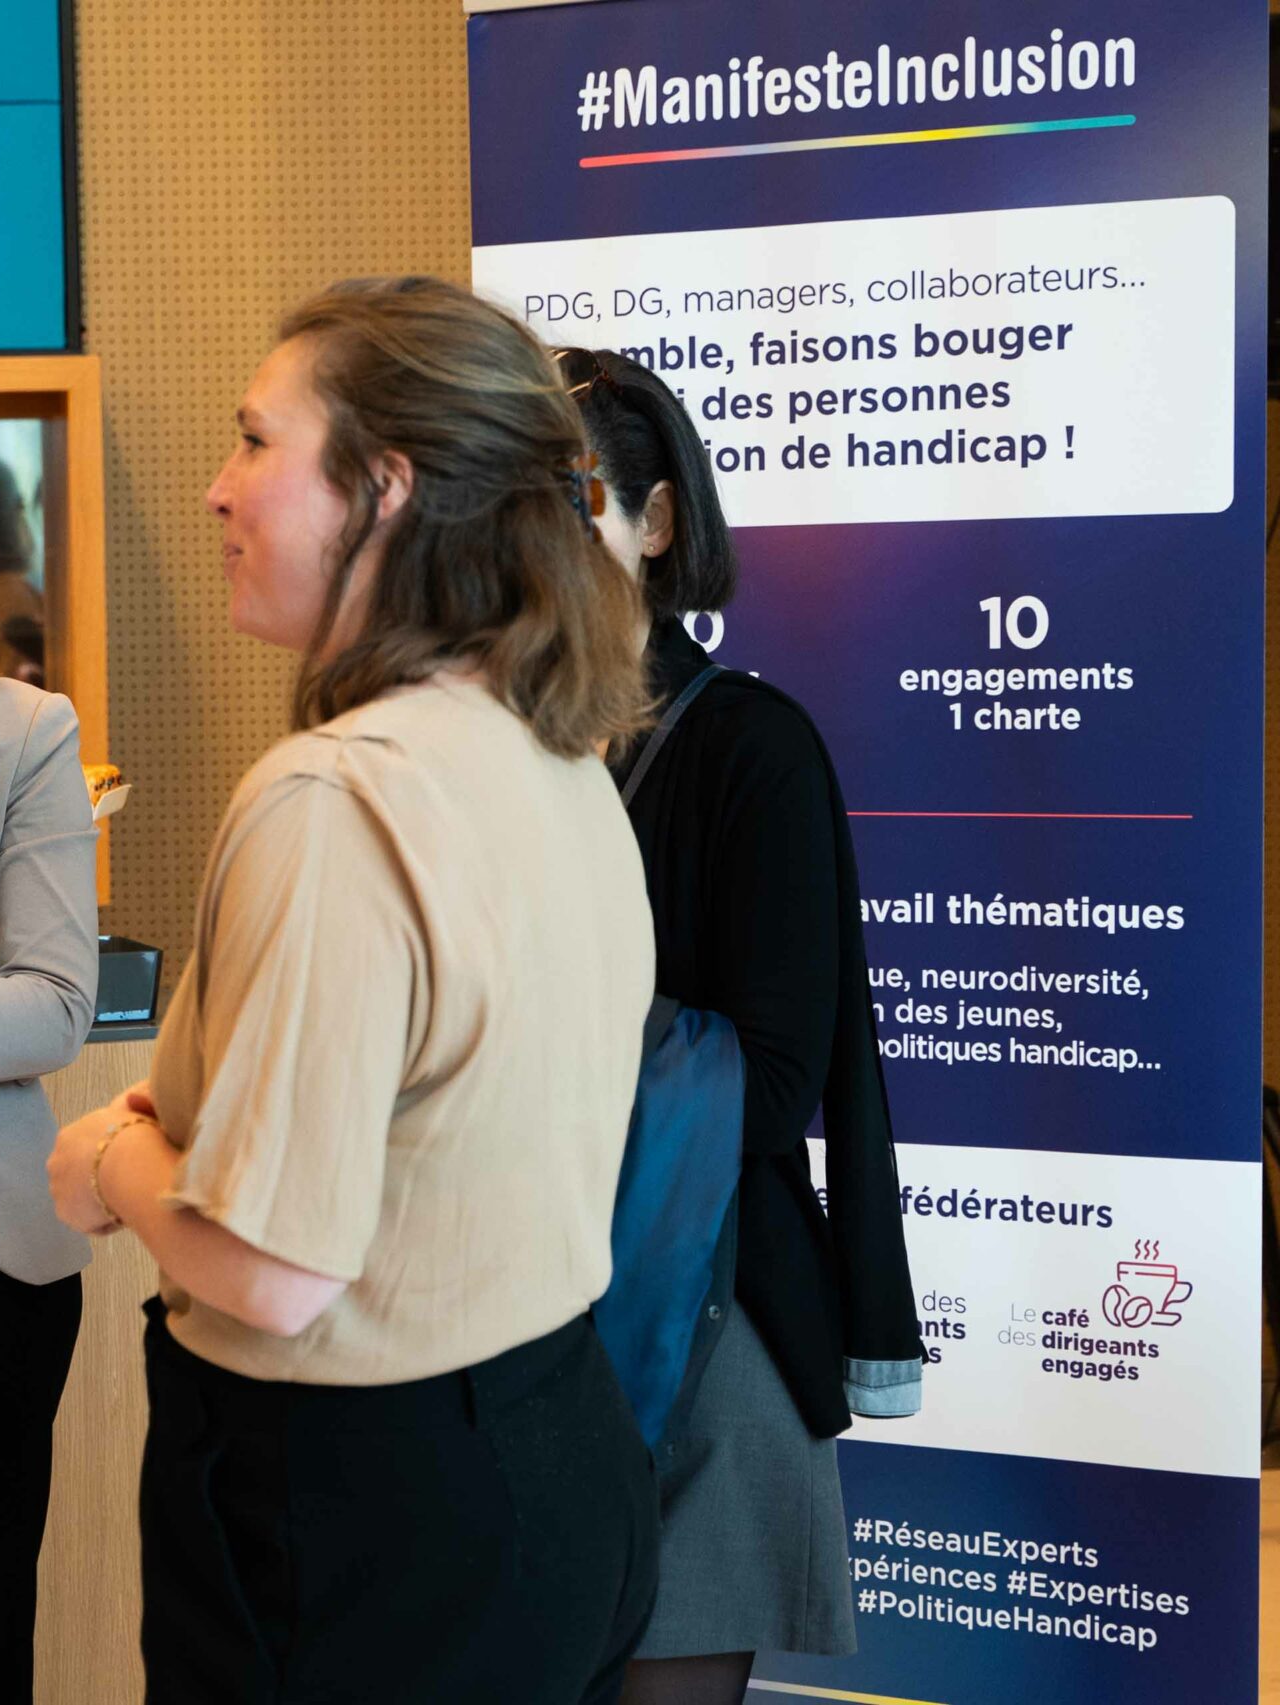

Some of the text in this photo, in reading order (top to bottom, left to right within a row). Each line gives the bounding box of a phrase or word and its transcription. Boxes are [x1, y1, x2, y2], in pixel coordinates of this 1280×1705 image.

[577, 29, 1135, 132] #ManifesteInclusion
[525, 264, 1145, 322] PDG, DG, managers, collaborateurs...
[620, 323, 1073, 375] mble, faisons bouger
[701, 387, 774, 421] des
[789, 382, 1010, 424] personnes
[781, 436, 831, 470] de
[847, 429, 1047, 469] handicap
[1065, 426, 1075, 460] !
[979, 596, 1050, 650] 10
[899, 663, 1134, 697] engagements
[949, 701, 1082, 731] 1 charte
[946, 893, 1185, 935] thématiques
[921, 966, 1149, 1001] neurodiversité,
[894, 998, 948, 1025] des
[956, 1000, 1063, 1034] jeunes,
[1009, 1038, 1161, 1073] handicap...
[900, 1186, 1113, 1228] fédérateurs
[922, 1290, 967, 1314] des
[1011, 1303, 1090, 1329] Le café
[997, 1326, 1160, 1359] des dirigeants
[1041, 1358, 1140, 1382] engagés
[853, 1518, 1099, 1567] #RéseauExperts
[1006, 1571, 1190, 1616] #Expertises
[857, 1589, 1158, 1650] #PolitiqueHandicap
